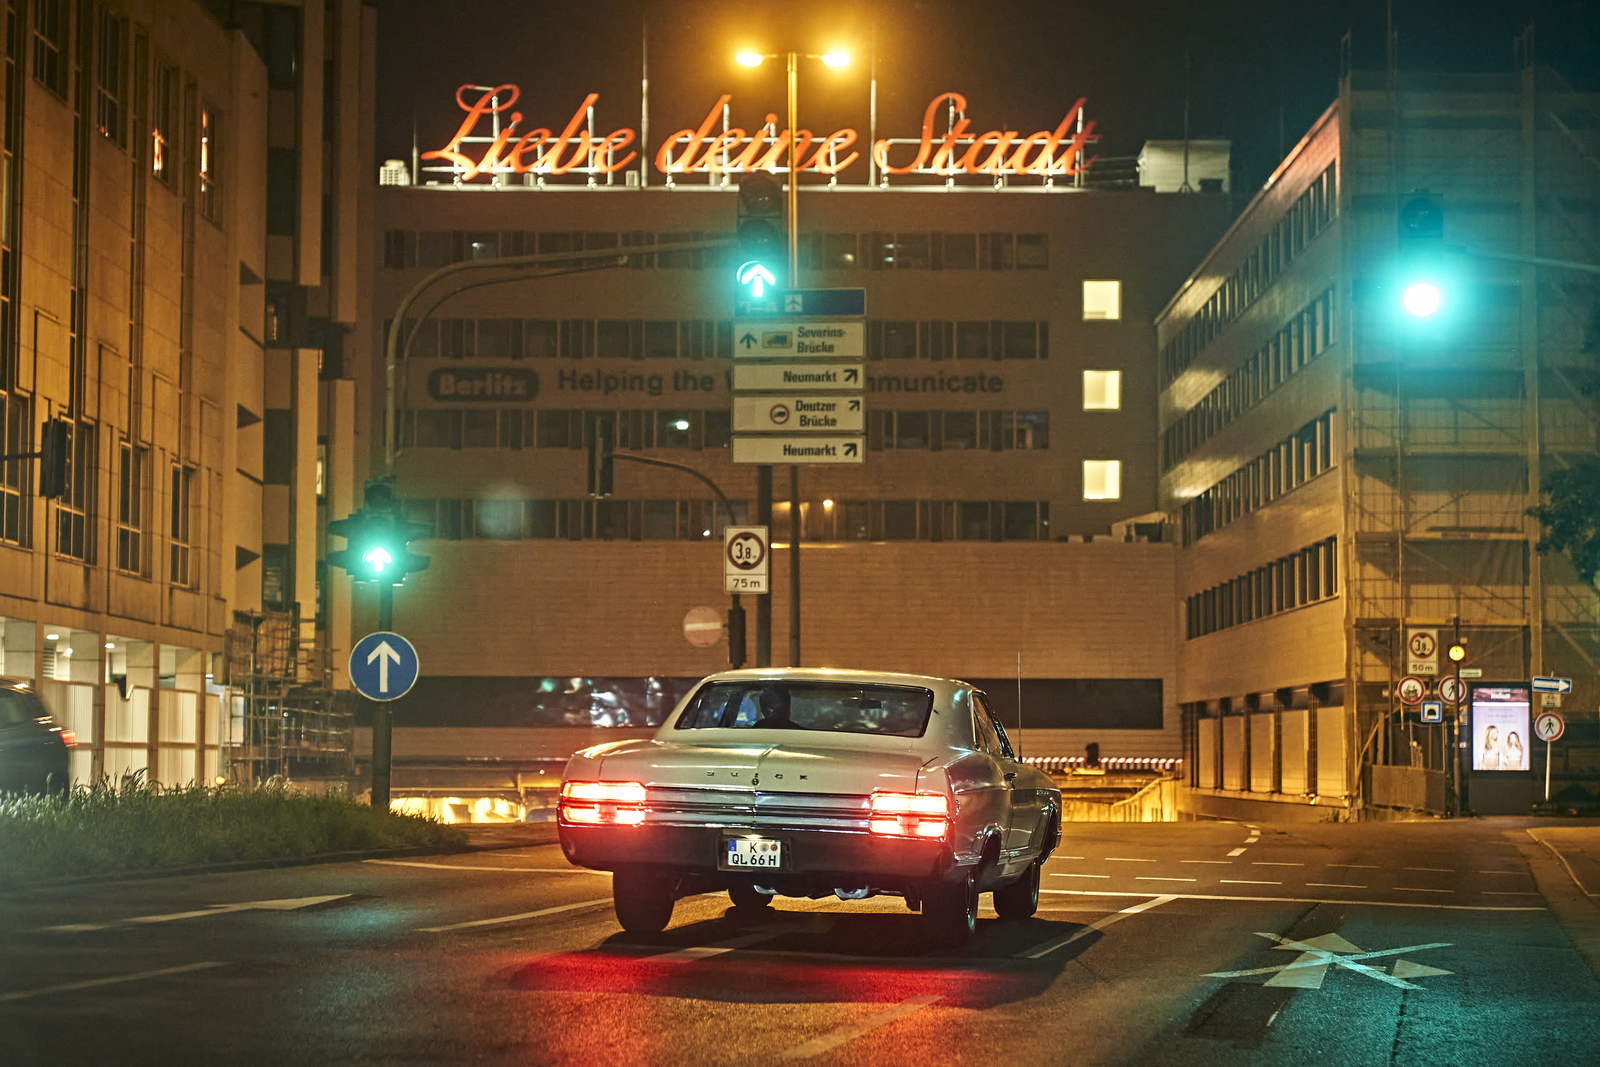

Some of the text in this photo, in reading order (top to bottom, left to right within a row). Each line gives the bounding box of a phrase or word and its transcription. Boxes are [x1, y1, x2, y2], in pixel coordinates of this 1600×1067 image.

[421, 84, 1101, 180] Liebe deine Stadt
[797, 341, 835, 353] Brücke
[783, 370, 837, 383] Neumarkt
[438, 373, 529, 395] Berlitz
[558, 369, 663, 397] Helping
[672, 370, 714, 392] the
[795, 400, 837, 412] Deutzer
[799, 414, 838, 427] Brücke
[783, 444, 837, 456] Heumarkt
[733, 578, 760, 588] 75 m
[1412, 664, 1424, 672] 50
[750, 842, 757, 853] K
[732, 854, 776, 866] QL 66 H
